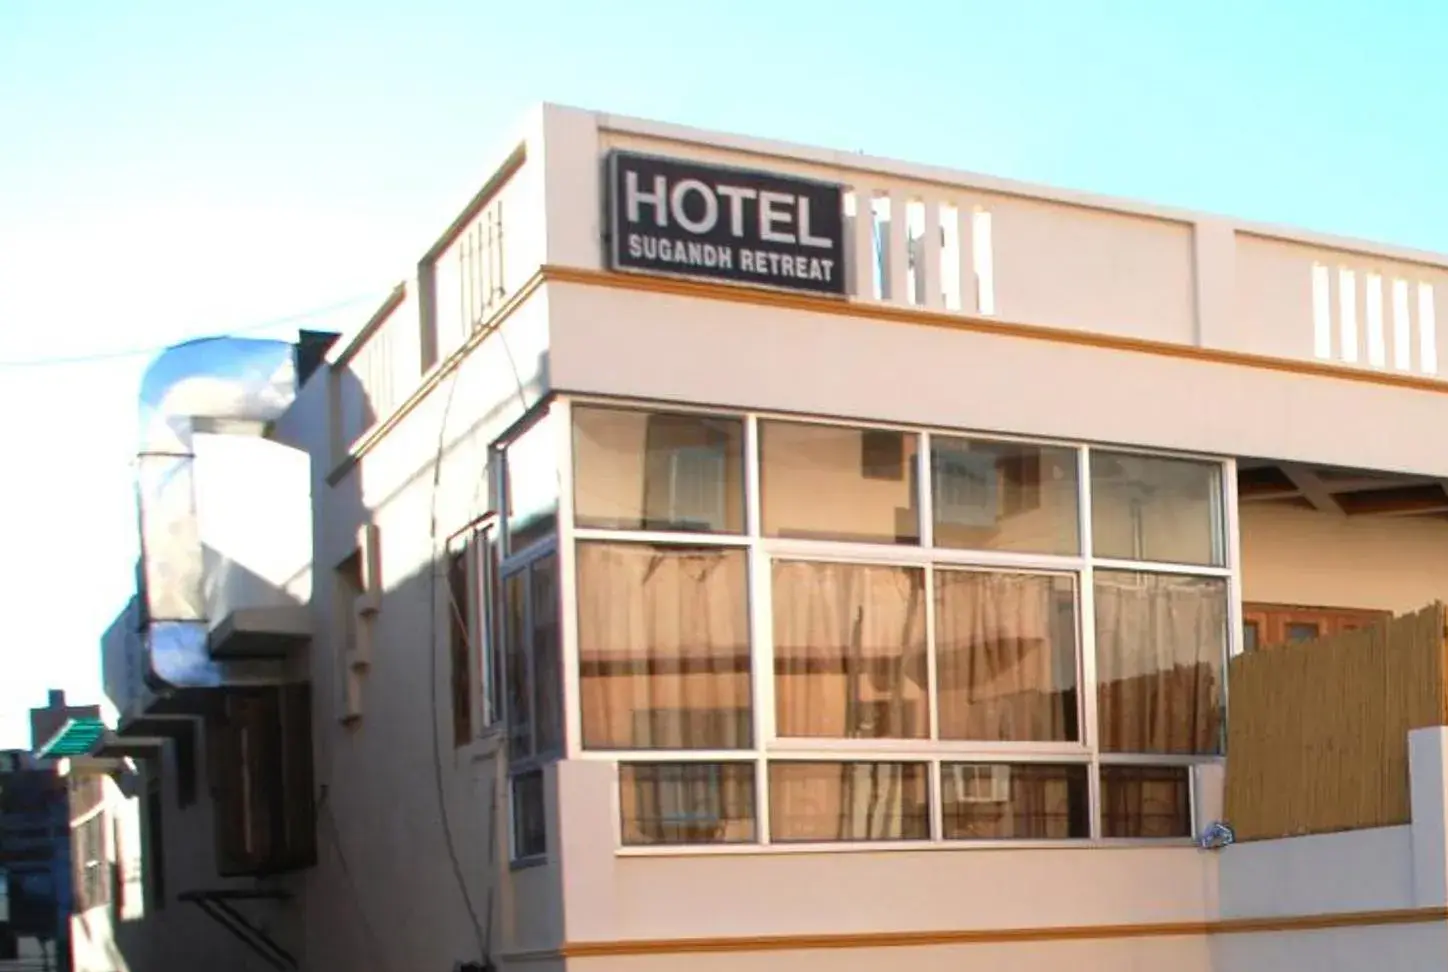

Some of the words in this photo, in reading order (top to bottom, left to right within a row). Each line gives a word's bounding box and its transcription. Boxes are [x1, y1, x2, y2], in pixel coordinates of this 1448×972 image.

[624, 170, 833, 249] HOTEL
[628, 233, 733, 269] SUGANDH
[740, 248, 835, 283] RETREAT
